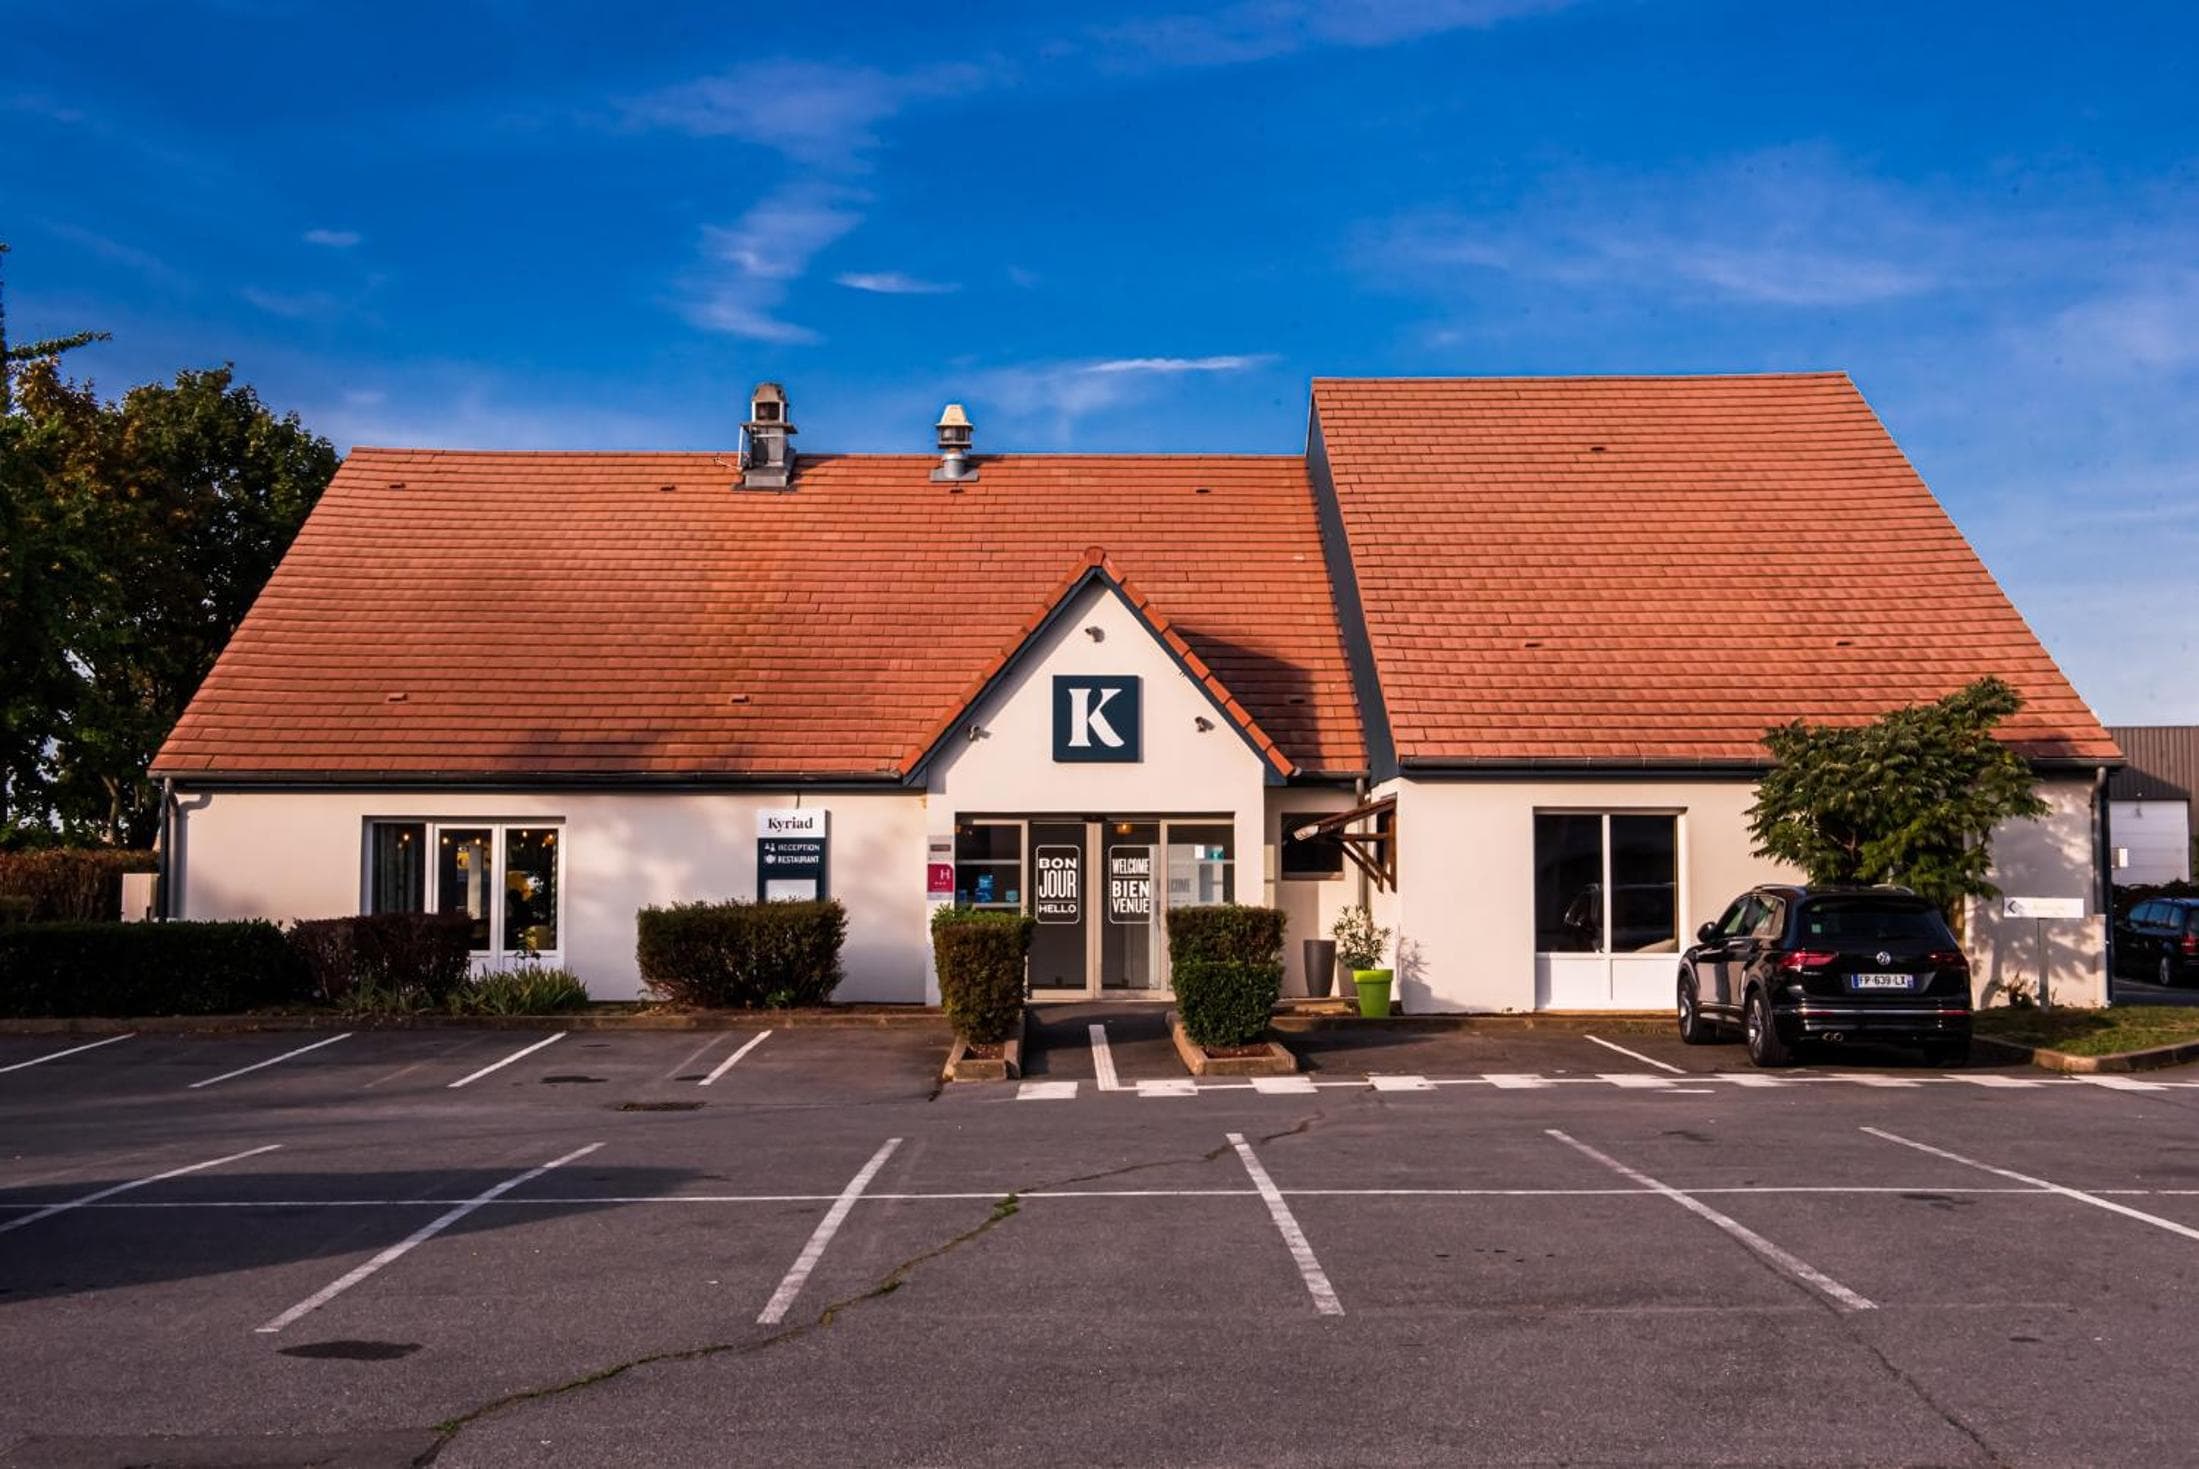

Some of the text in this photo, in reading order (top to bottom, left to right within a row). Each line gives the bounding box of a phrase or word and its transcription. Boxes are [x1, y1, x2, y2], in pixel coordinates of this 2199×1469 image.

[1067, 688, 1125, 748] K
[768, 816, 813, 833] Kyriad
[777, 855, 820, 864] RESTAURANT
[1038, 857, 1077, 869] BON
[1111, 858, 1150, 874] WELCOME
[940, 868, 951, 880] H
[1038, 870, 1077, 898] JOUR
[1112, 880, 1150, 898] BIEN
[1038, 904, 1077, 914] HELLO
[1112, 898, 1150, 914] VENUE
